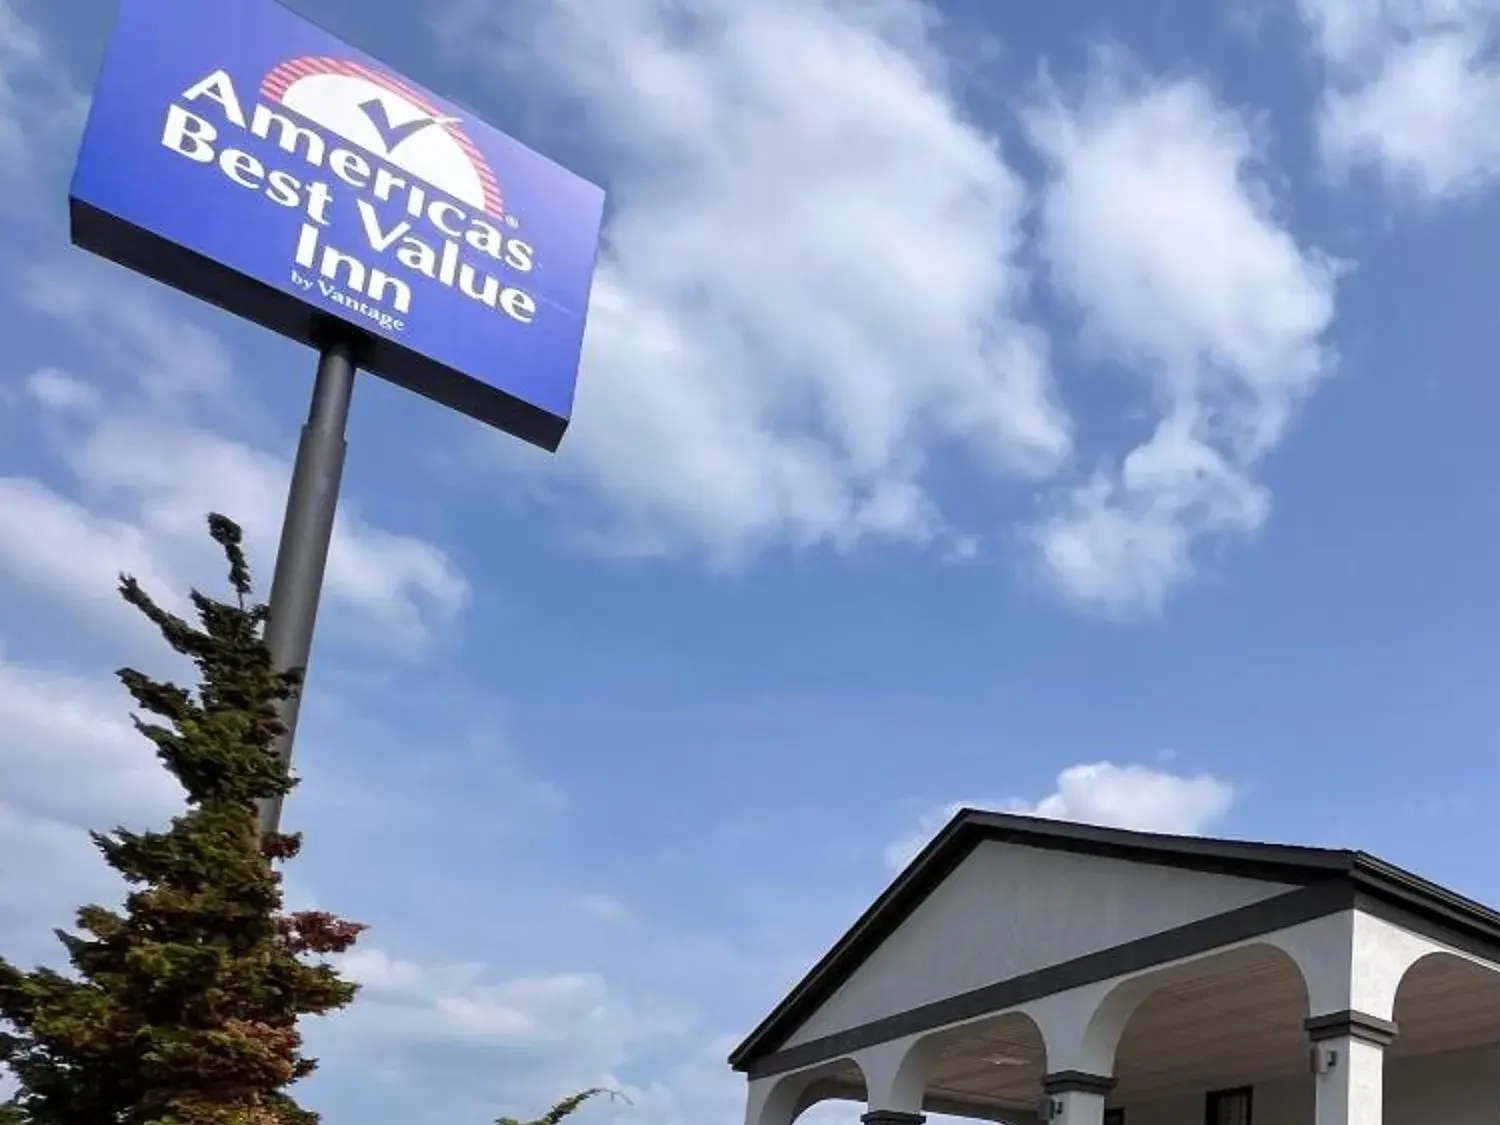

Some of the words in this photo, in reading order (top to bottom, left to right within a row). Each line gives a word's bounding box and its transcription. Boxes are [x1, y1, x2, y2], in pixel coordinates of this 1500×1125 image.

[161, 104, 333, 225] Best
[356, 198, 537, 325] Value
[183, 69, 534, 273] Americas
[291, 269, 314, 291] by
[318, 279, 405, 331] Vantage
[295, 222, 411, 314] Inn
